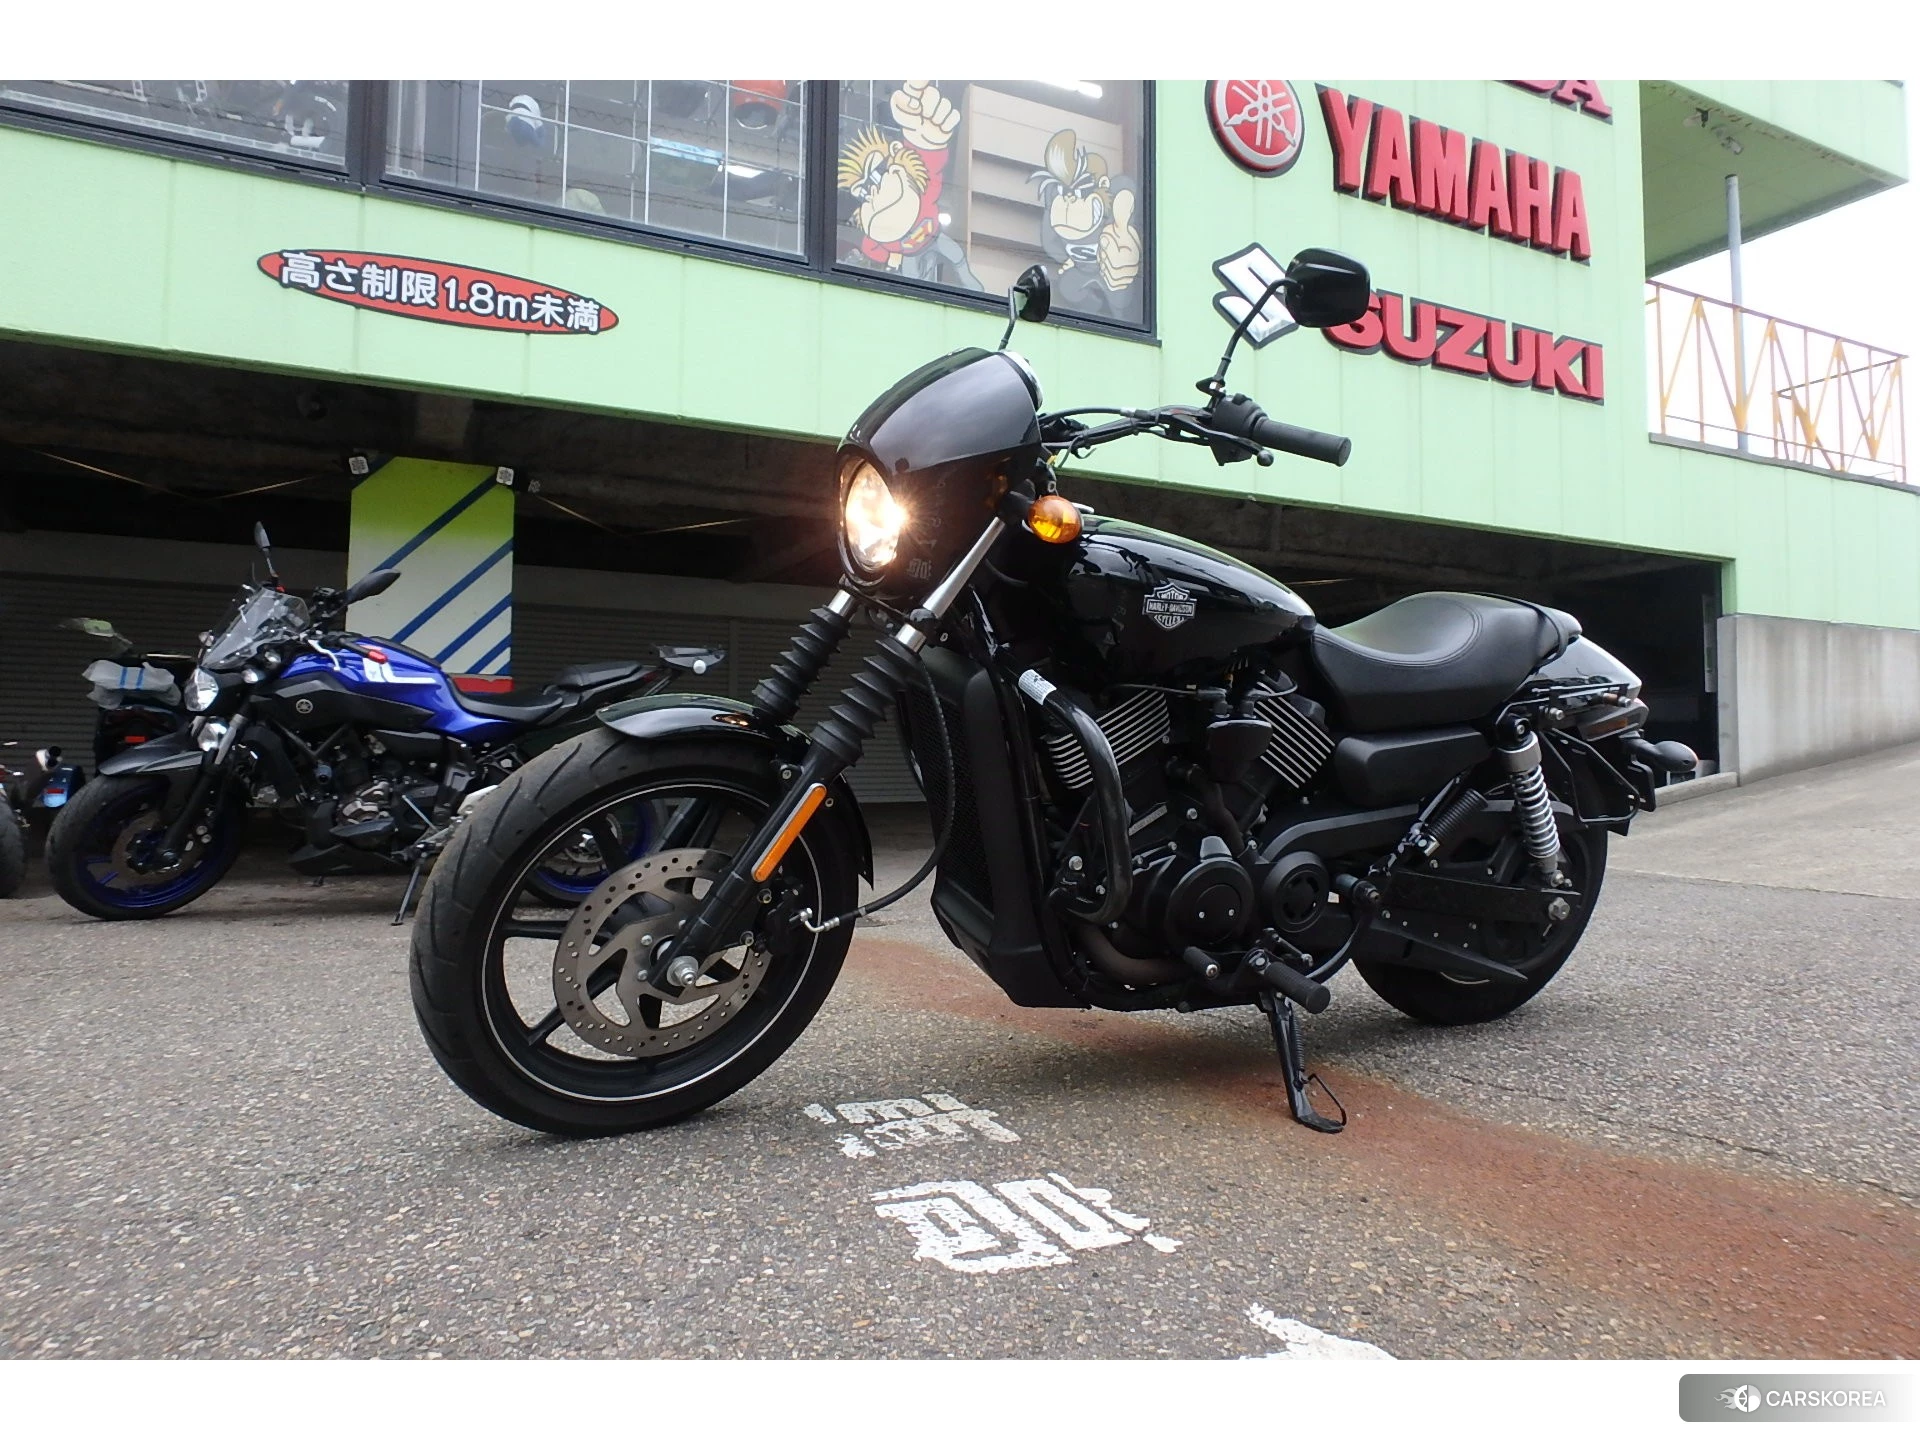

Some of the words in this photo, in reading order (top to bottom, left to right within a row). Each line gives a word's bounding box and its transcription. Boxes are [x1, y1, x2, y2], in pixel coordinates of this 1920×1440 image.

[1317, 86, 1592, 262] YAMAHA
[281, 250, 601, 332] 高さ制限1.8m未満
[1148, 601, 1193, 614] HARLEY-DAVIDSON
